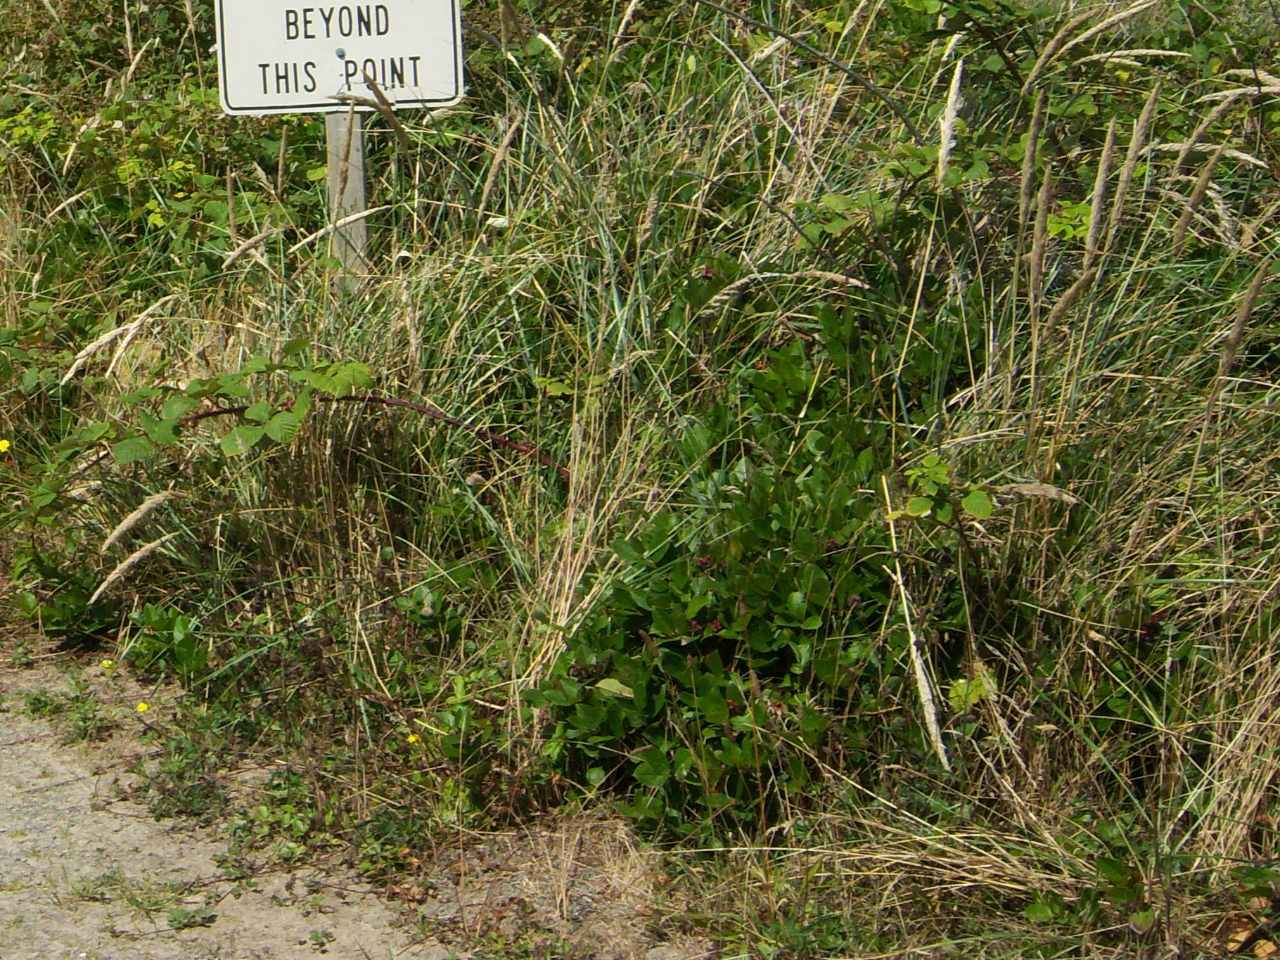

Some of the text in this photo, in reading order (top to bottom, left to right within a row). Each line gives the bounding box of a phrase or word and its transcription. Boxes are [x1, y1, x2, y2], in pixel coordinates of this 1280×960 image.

[285, 4, 389, 40] BEYOND
[258, 56, 421, 95] THIS POINT
